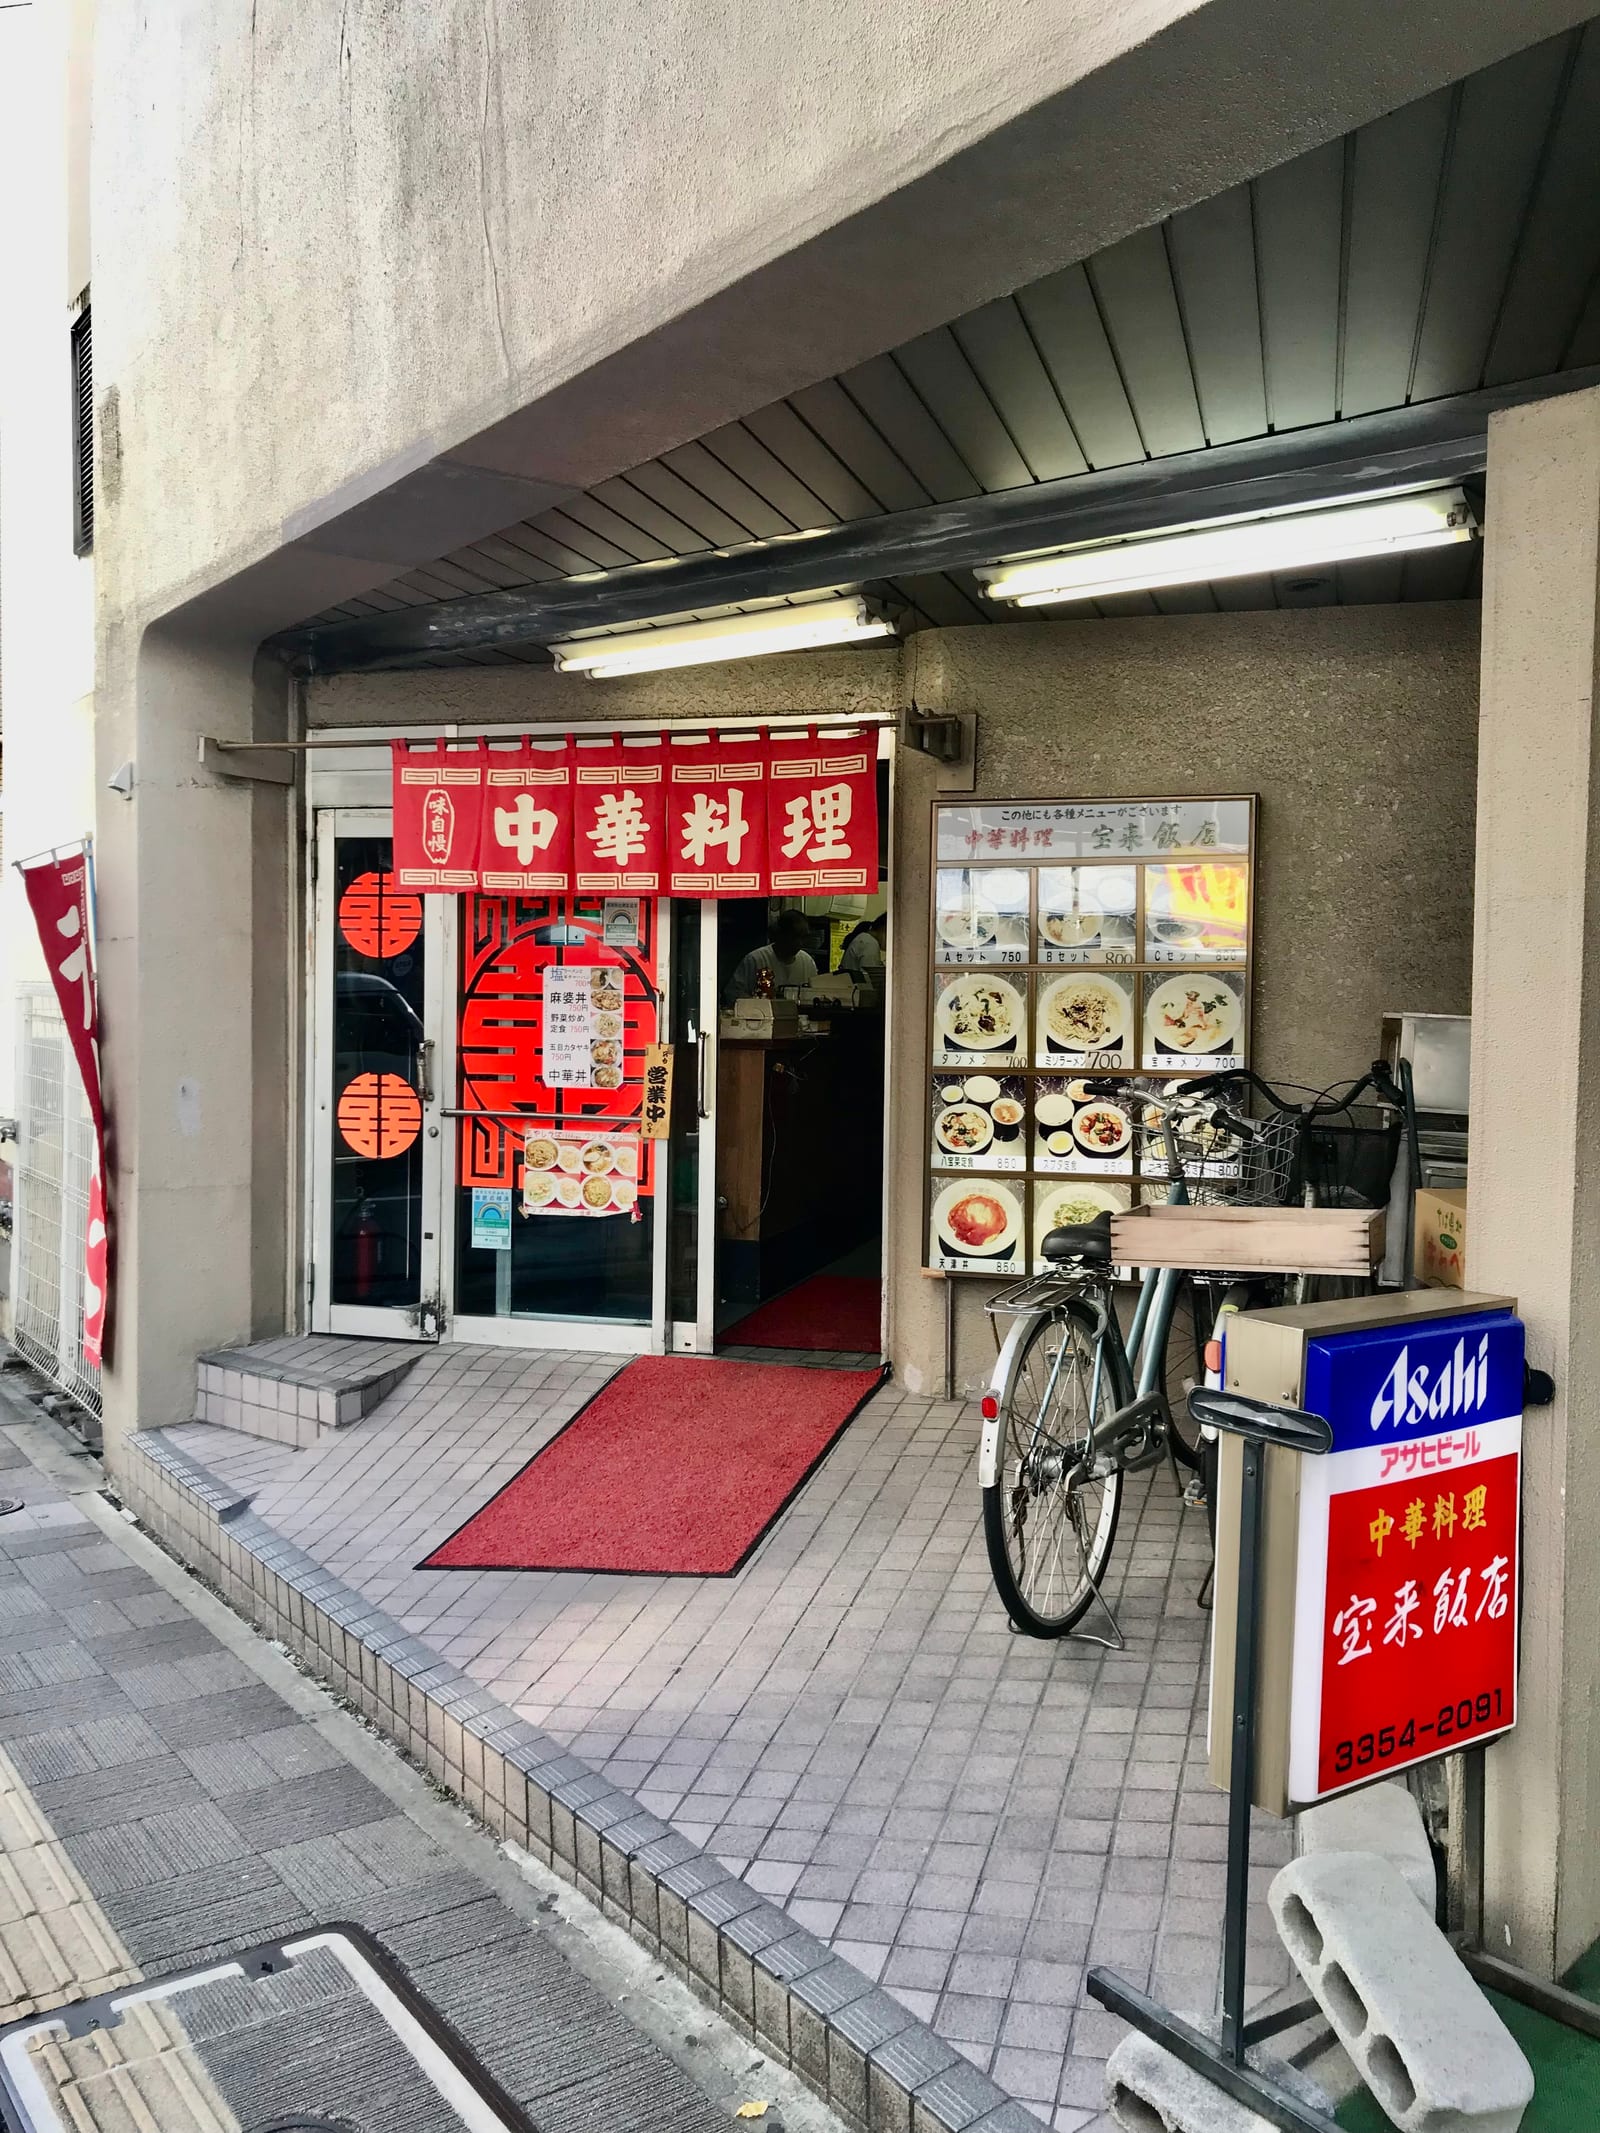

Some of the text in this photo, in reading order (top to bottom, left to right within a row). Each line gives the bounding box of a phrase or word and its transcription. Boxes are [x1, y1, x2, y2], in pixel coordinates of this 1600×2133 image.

[427, 792, 450, 853] 味自慢
[494, 782, 852, 866] 中華料理
[964, 820, 1218, 852] 中華料理 宝来飯店
[1001, 951, 1021, 962] 750
[1105, 951, 1133, 964] 800
[550, 992, 587, 1004] 麻婆丼
[551, 1014, 585, 1022] 野菜炒め
[550, 1025, 566, 1033] 定食
[1006, 1056, 1027, 1068] 700
[1088, 1051, 1122, 1069] 700
[1215, 1057, 1235, 1068] 700
[549, 1069, 587, 1082] 中華丼
[646, 1066, 668, 1122] 営業中
[996, 1262, 1016, 1273] 850
[1370, 1333, 1488, 1431] Asahi
[1379, 1430, 1481, 1478] アサヒビール
[1368, 1484, 1488, 1557] 中華料理
[1332, 1555, 1509, 1666] 宝来飯店
[1334, 1688, 1503, 1774] 3354-2091
